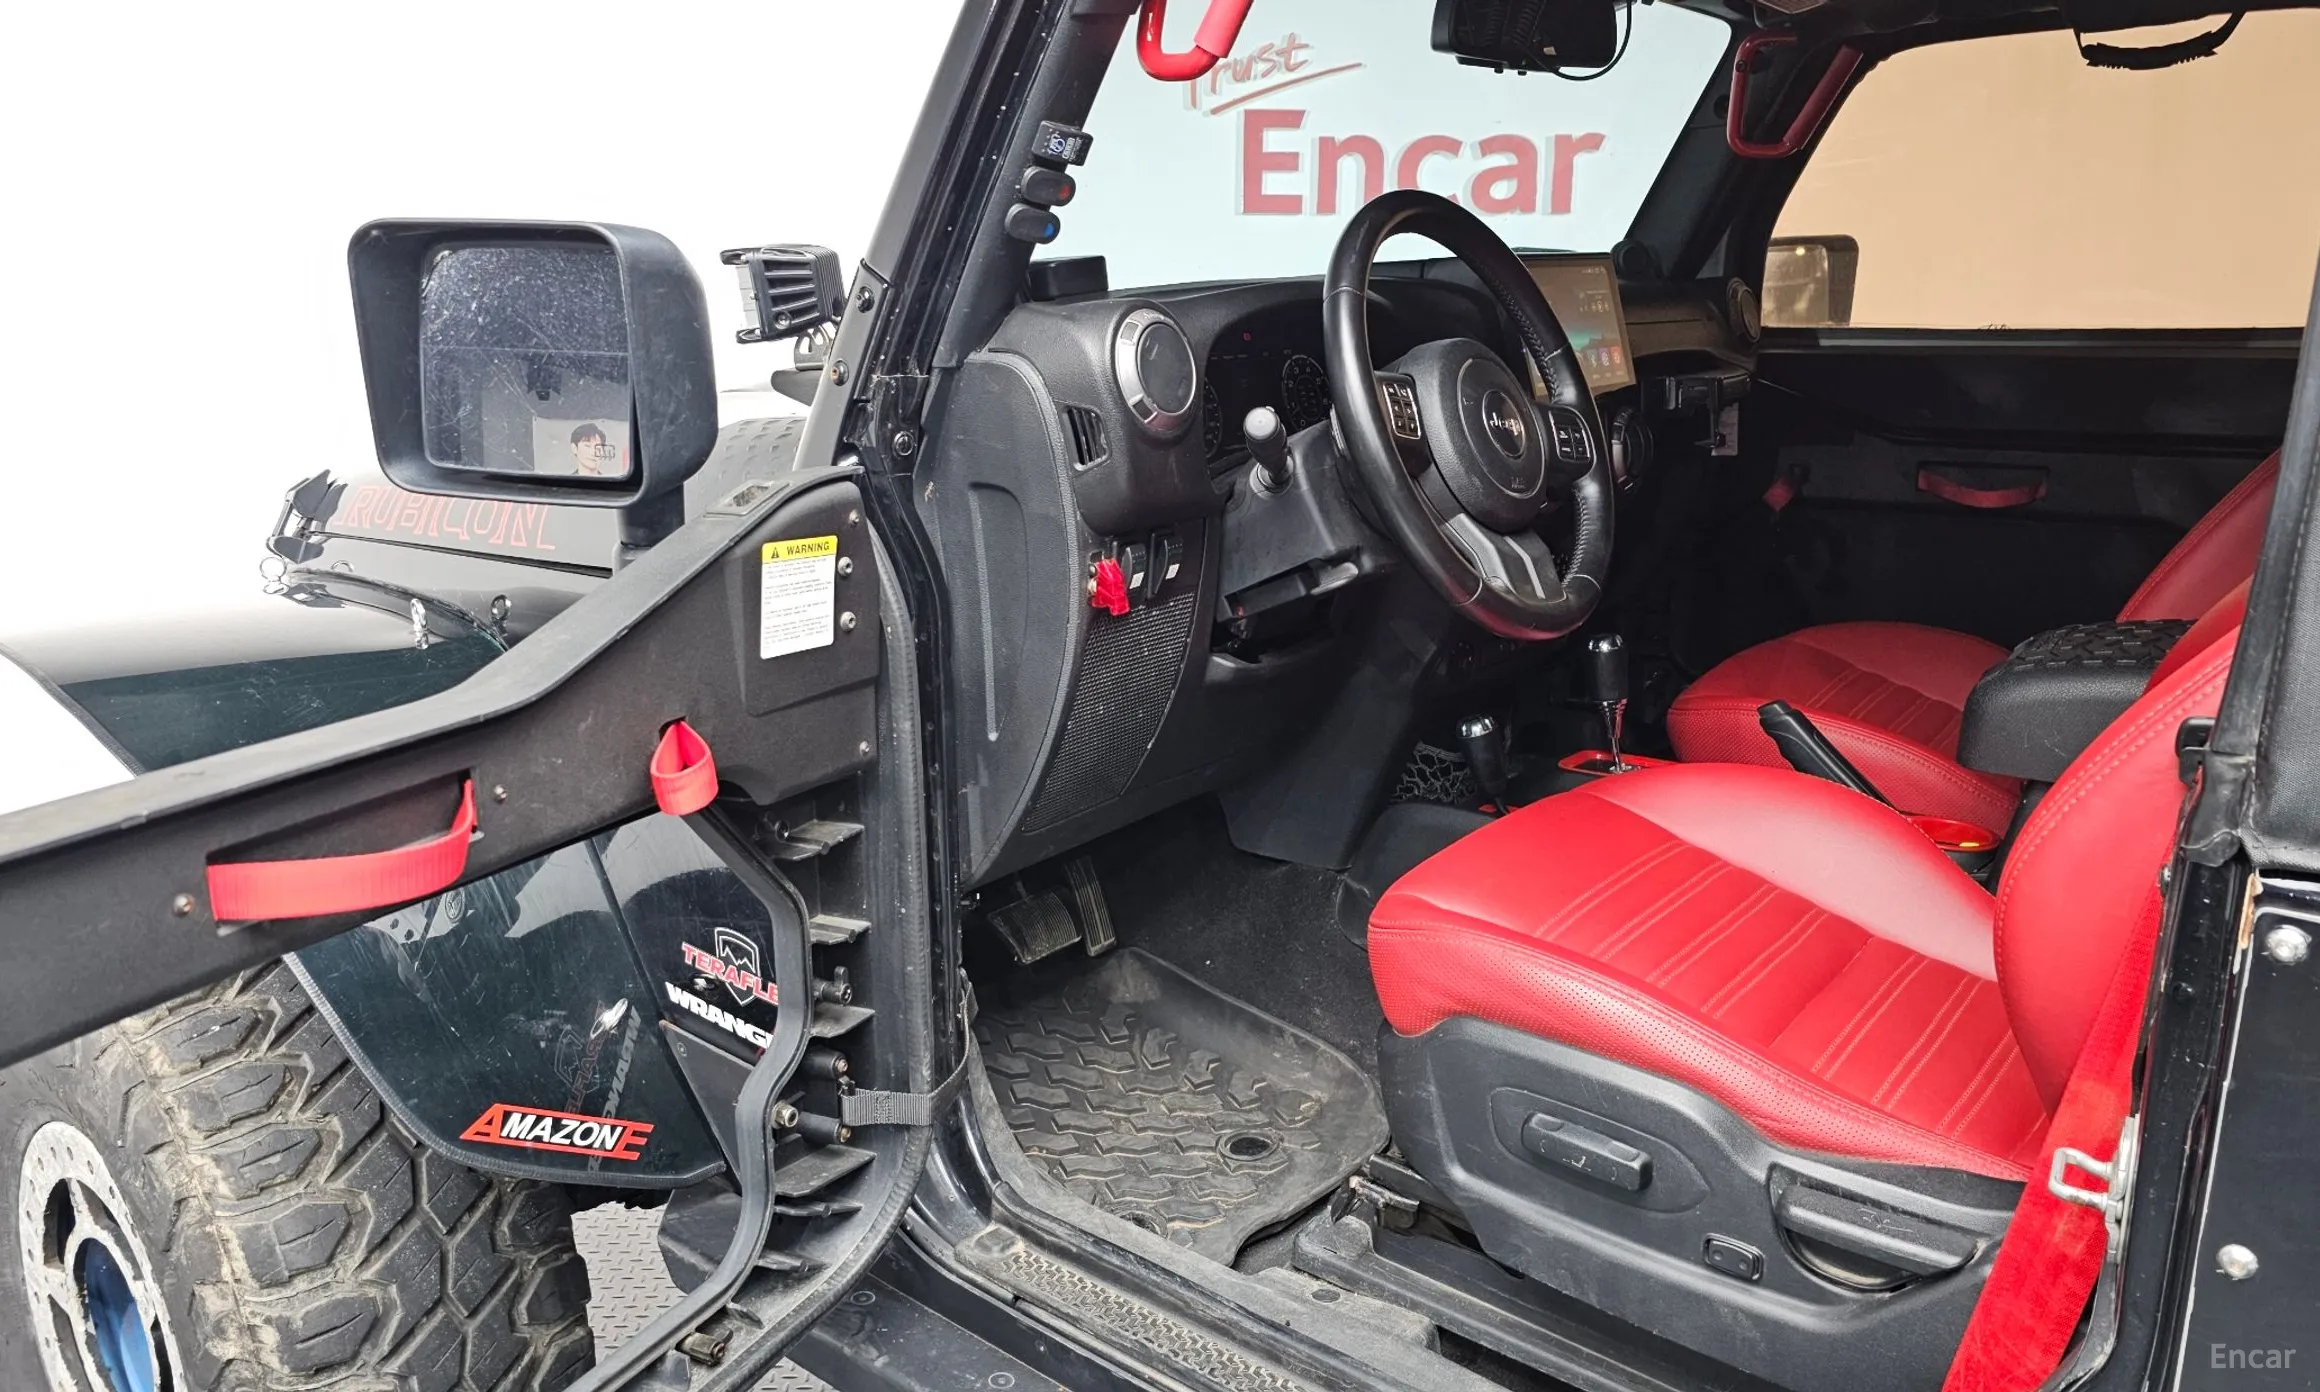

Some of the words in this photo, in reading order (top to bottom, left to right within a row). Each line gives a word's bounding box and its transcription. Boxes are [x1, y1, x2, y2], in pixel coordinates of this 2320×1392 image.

[1242, 109, 1606, 216] Encar
[787, 541, 830, 556] WARNING
[664, 981, 775, 1050] WRANG
[458, 1102, 655, 1161] AMAZONE
